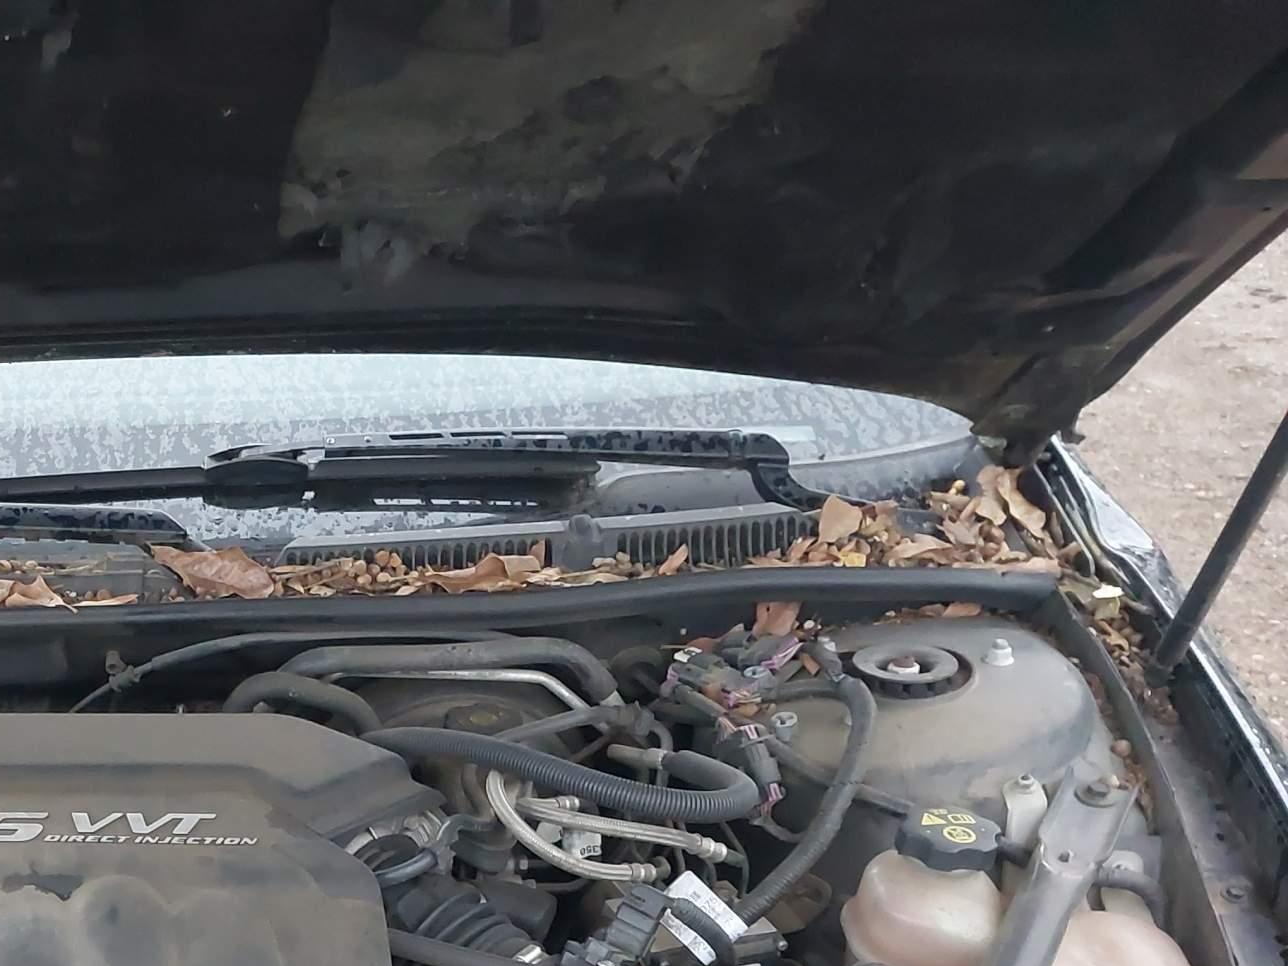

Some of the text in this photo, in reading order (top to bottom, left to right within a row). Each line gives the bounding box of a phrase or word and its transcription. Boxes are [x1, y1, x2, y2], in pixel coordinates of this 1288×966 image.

[71, 812, 217, 835] VVT
[44, 834, 258, 846] DIRECT INJECTION
